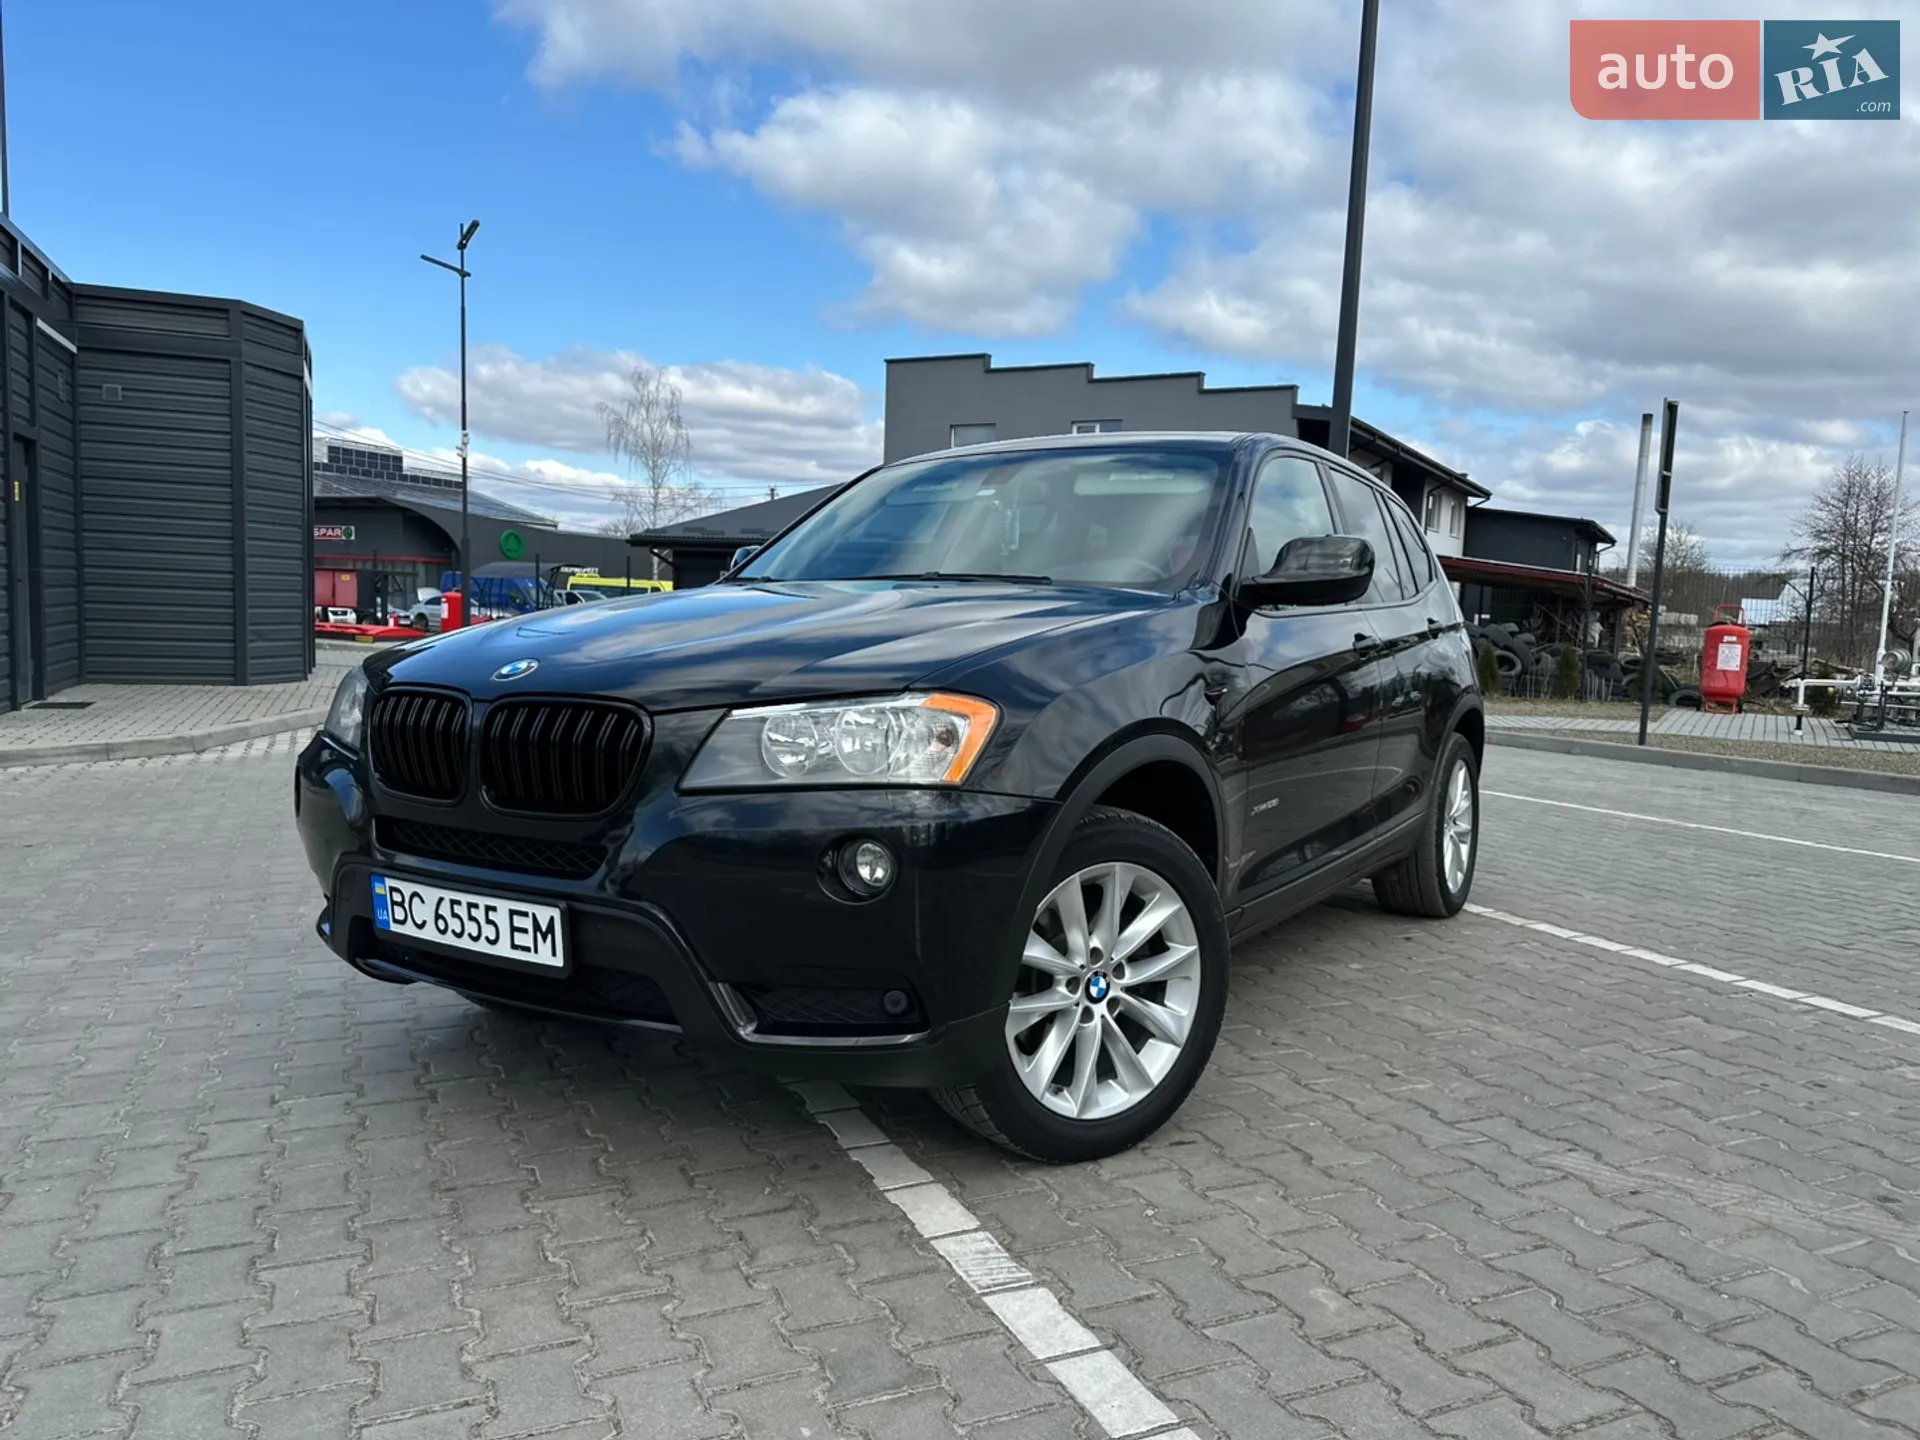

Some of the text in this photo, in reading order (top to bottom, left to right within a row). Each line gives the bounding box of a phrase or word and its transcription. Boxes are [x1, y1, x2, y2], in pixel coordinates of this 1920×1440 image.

[377, 908, 389, 920] UA
[388, 885, 558, 957] BC 6555 EM
